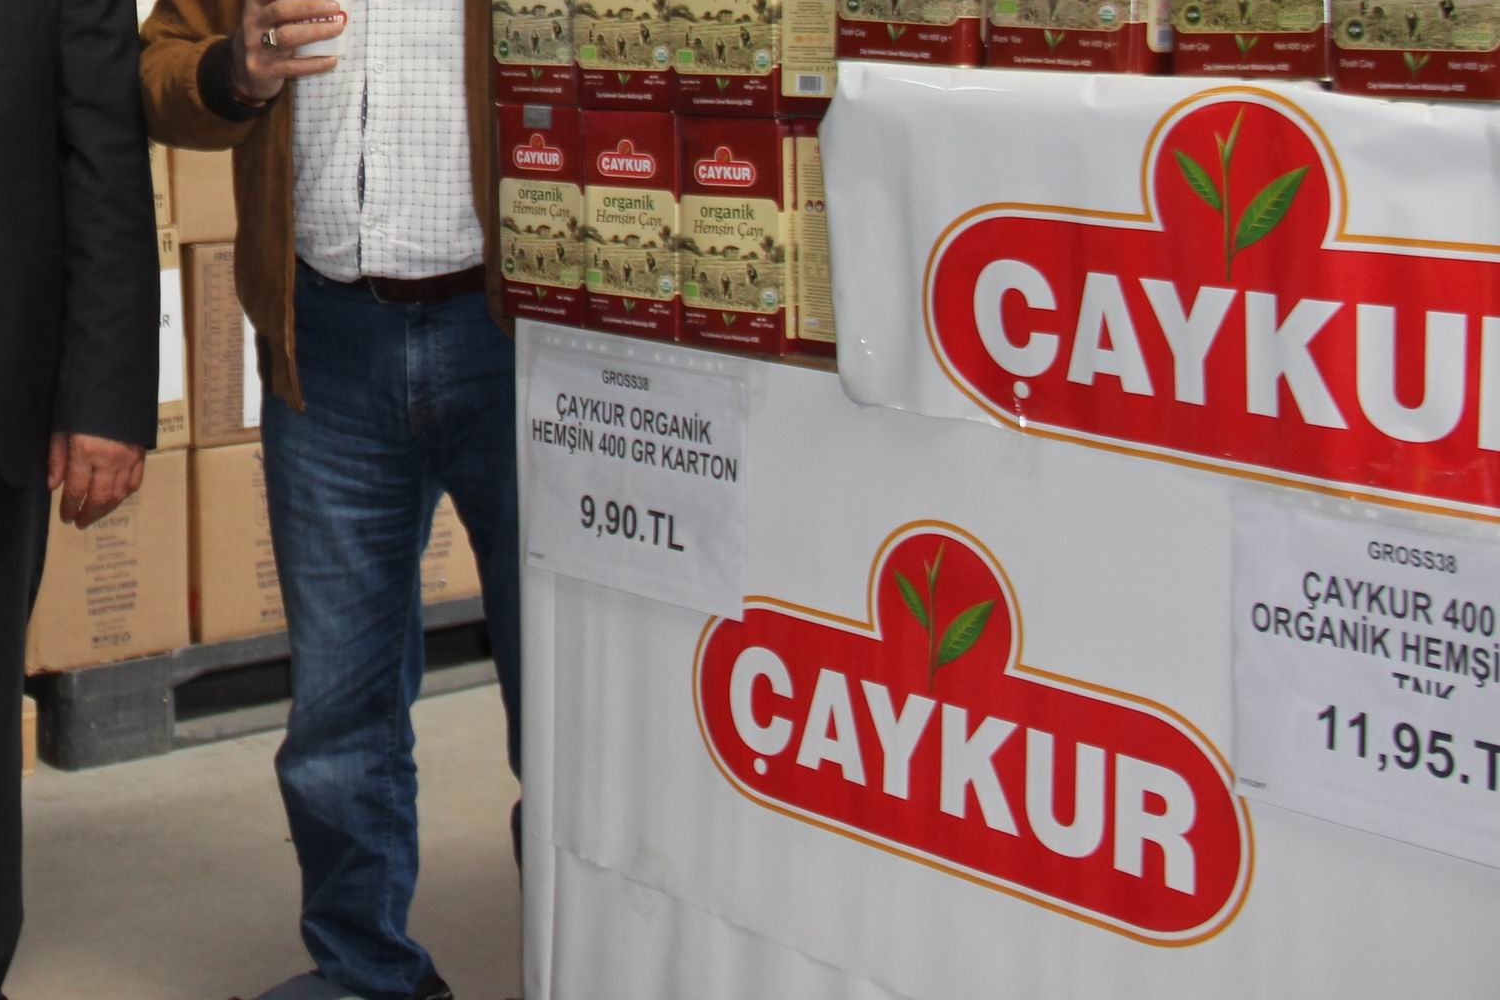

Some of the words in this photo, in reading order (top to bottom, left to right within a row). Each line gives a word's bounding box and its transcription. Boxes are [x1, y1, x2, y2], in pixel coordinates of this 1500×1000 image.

[601, 156, 651, 176] ÇAYKUR
[699, 165, 751, 184] ÇAYKUR
[518, 185, 563, 206] organik
[603, 194, 654, 214] organik
[700, 203, 754, 224] organik
[972, 258, 1500, 453] ÇAYKU
[602, 370, 649, 391] GROSS38
[556, 393, 625, 427] ÇAYKUR
[630, 407, 712, 445] ORGANİK
[532, 419, 594, 454] HEMŞİN
[598, 433, 626, 459] 400
[631, 438, 656, 465] GR
[662, 445, 738, 483] KARTON
[580, 495, 684, 551] 9,90.TL
[1368, 541, 1457, 574] GROSS38
[1303, 571, 1433, 625] ÇAYKUR
[1442, 598, 1495, 637] 400
[1252, 602, 1390, 658] ORGANİK
[729, 646, 1196, 897] ÇAYKUR
